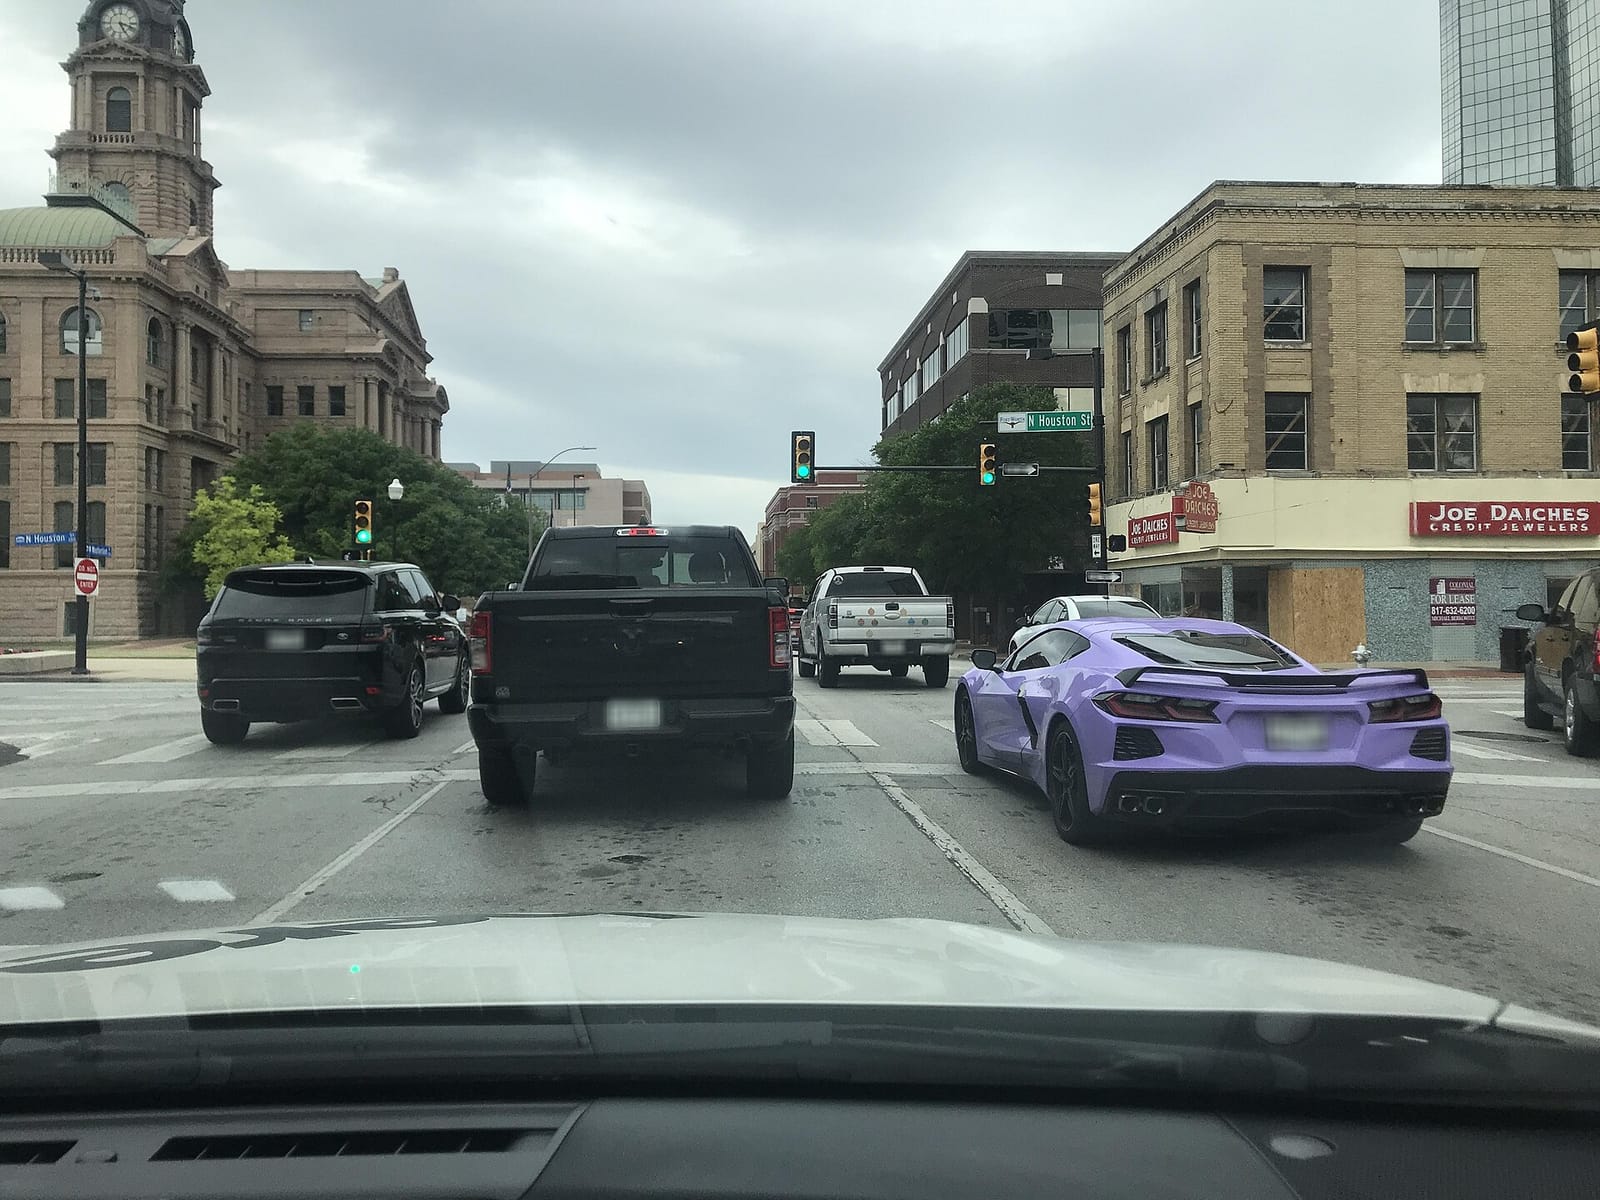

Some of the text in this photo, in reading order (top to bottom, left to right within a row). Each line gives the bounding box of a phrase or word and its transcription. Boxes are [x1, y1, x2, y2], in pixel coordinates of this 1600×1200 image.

[1028, 413, 1091, 427] N Houston St
[1192, 484, 1208, 500] JOE
[1185, 499, 1216, 517] DAICHES
[1429, 504, 1590, 521] JOE DAICHES
[1131, 521, 1142, 536] JOE
[1142, 517, 1168, 534] DAICHES
[1429, 523, 1589, 532] CREDIT JEWELERS
[25, 536, 32, 544] N
[34, 534, 65, 544] Houston
[1430, 594, 1475, 604] FOR LEASE
[1431, 606, 1476, 615] 817-632-6200
